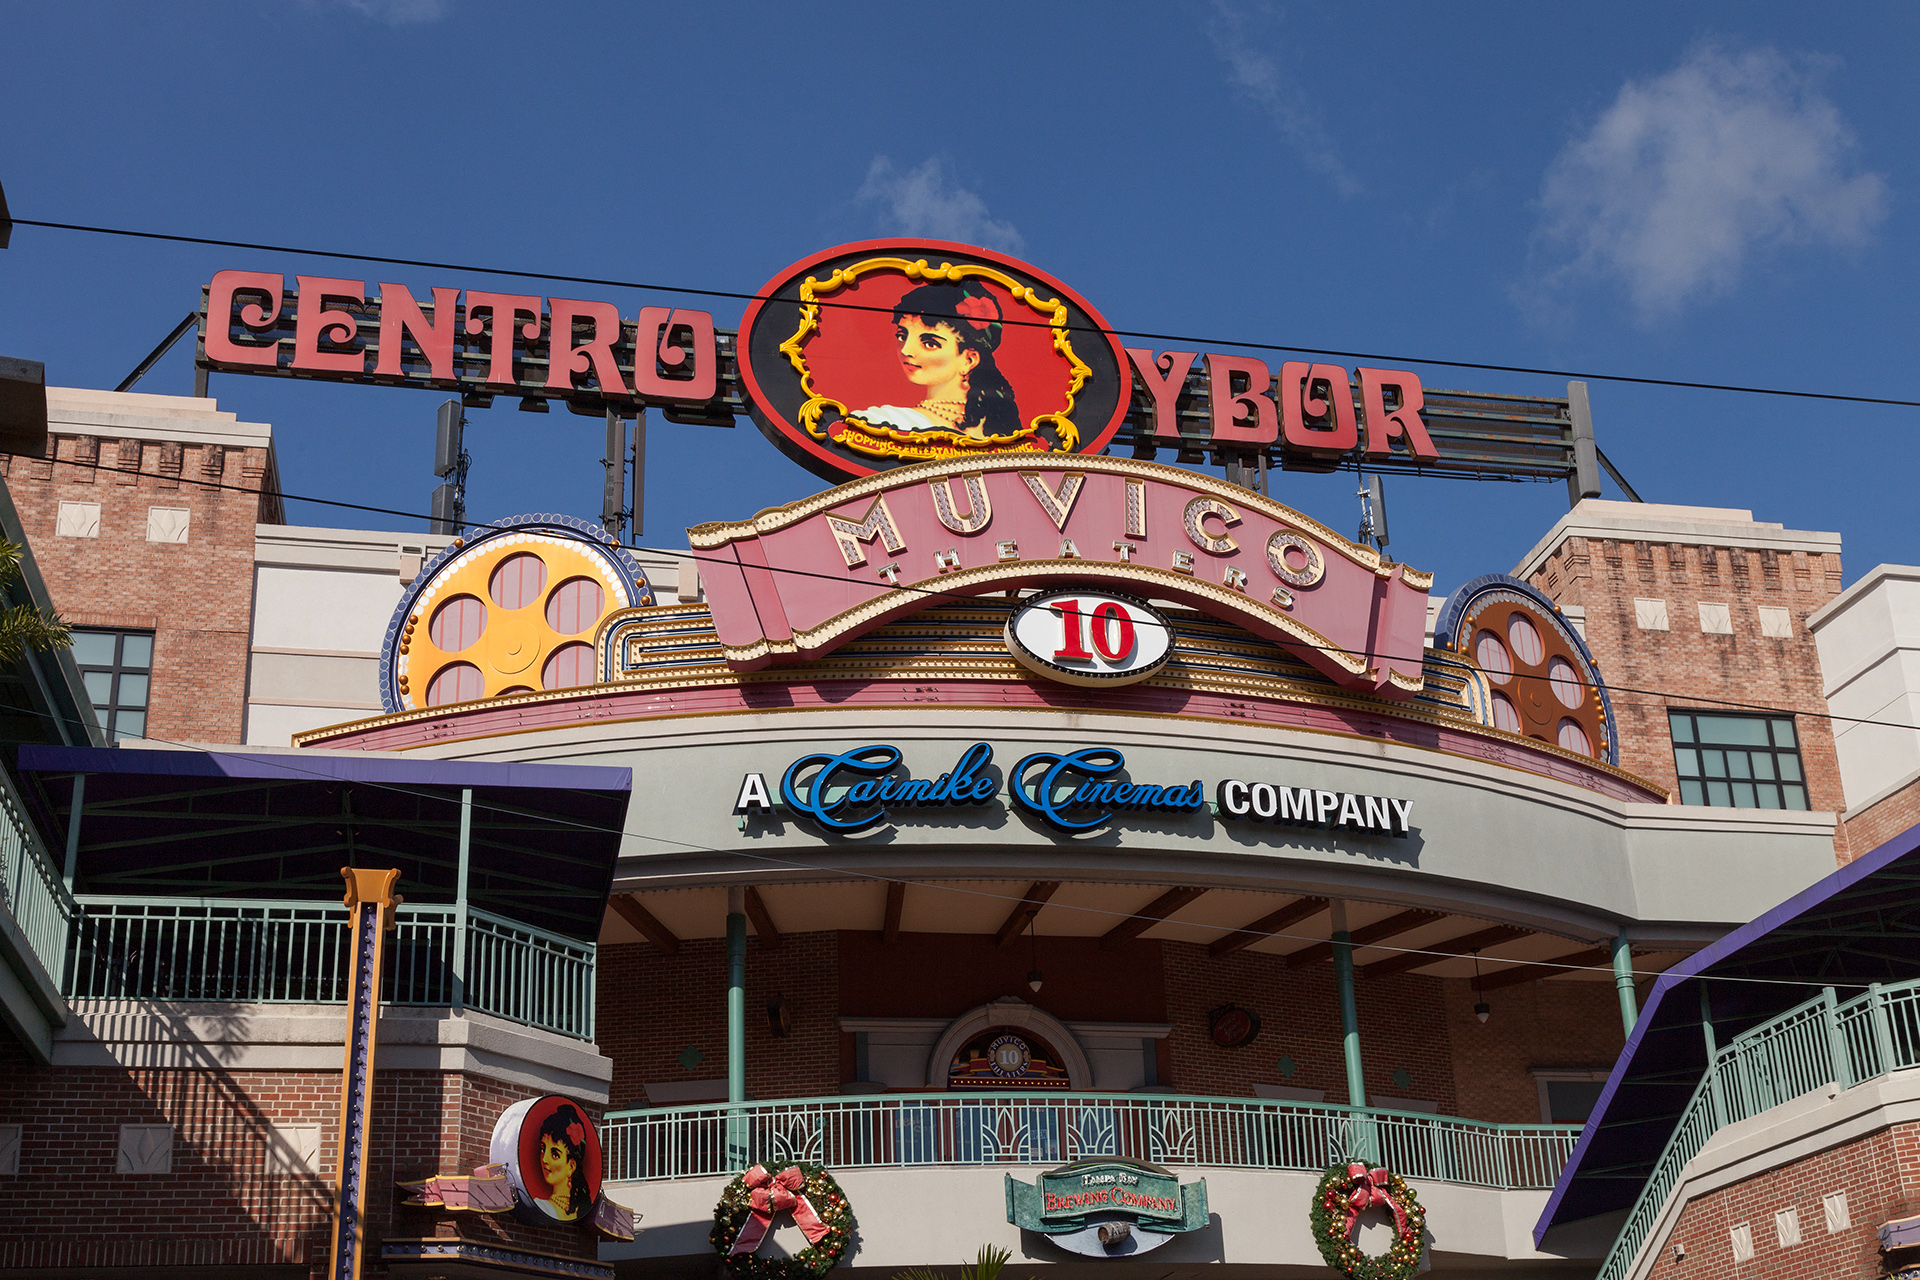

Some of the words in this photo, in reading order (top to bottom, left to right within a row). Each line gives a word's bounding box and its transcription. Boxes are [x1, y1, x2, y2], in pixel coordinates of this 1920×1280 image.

[204, 269, 717, 401] CENTRO
[1124, 347, 1441, 464] YBOR
[842, 428, 895, 451] SHOPPING
[994, 441, 1034, 453] DINING
[824, 470, 1326, 588] MUVICO
[877, 539, 1296, 611] THEATERS
[1050, 600, 1138, 664] 10
[735, 772, 773, 815] A
[781, 743, 996, 834] Carmike
[1010, 747, 1204, 833] Cinemas
[1218, 778, 1415, 838] COMPANY
[990, 1035, 1028, 1051] MUVICO
[989, 1060, 1029, 1079] THEATERS
[1000, 1050, 1019, 1065] 10
[1082, 1174, 1116, 1185] TAMPA
[1119, 1172, 1139, 1184] BAY
[1045, 1190, 1109, 1211] BREWING
[1111, 1187, 1176, 1212] COMPANY
